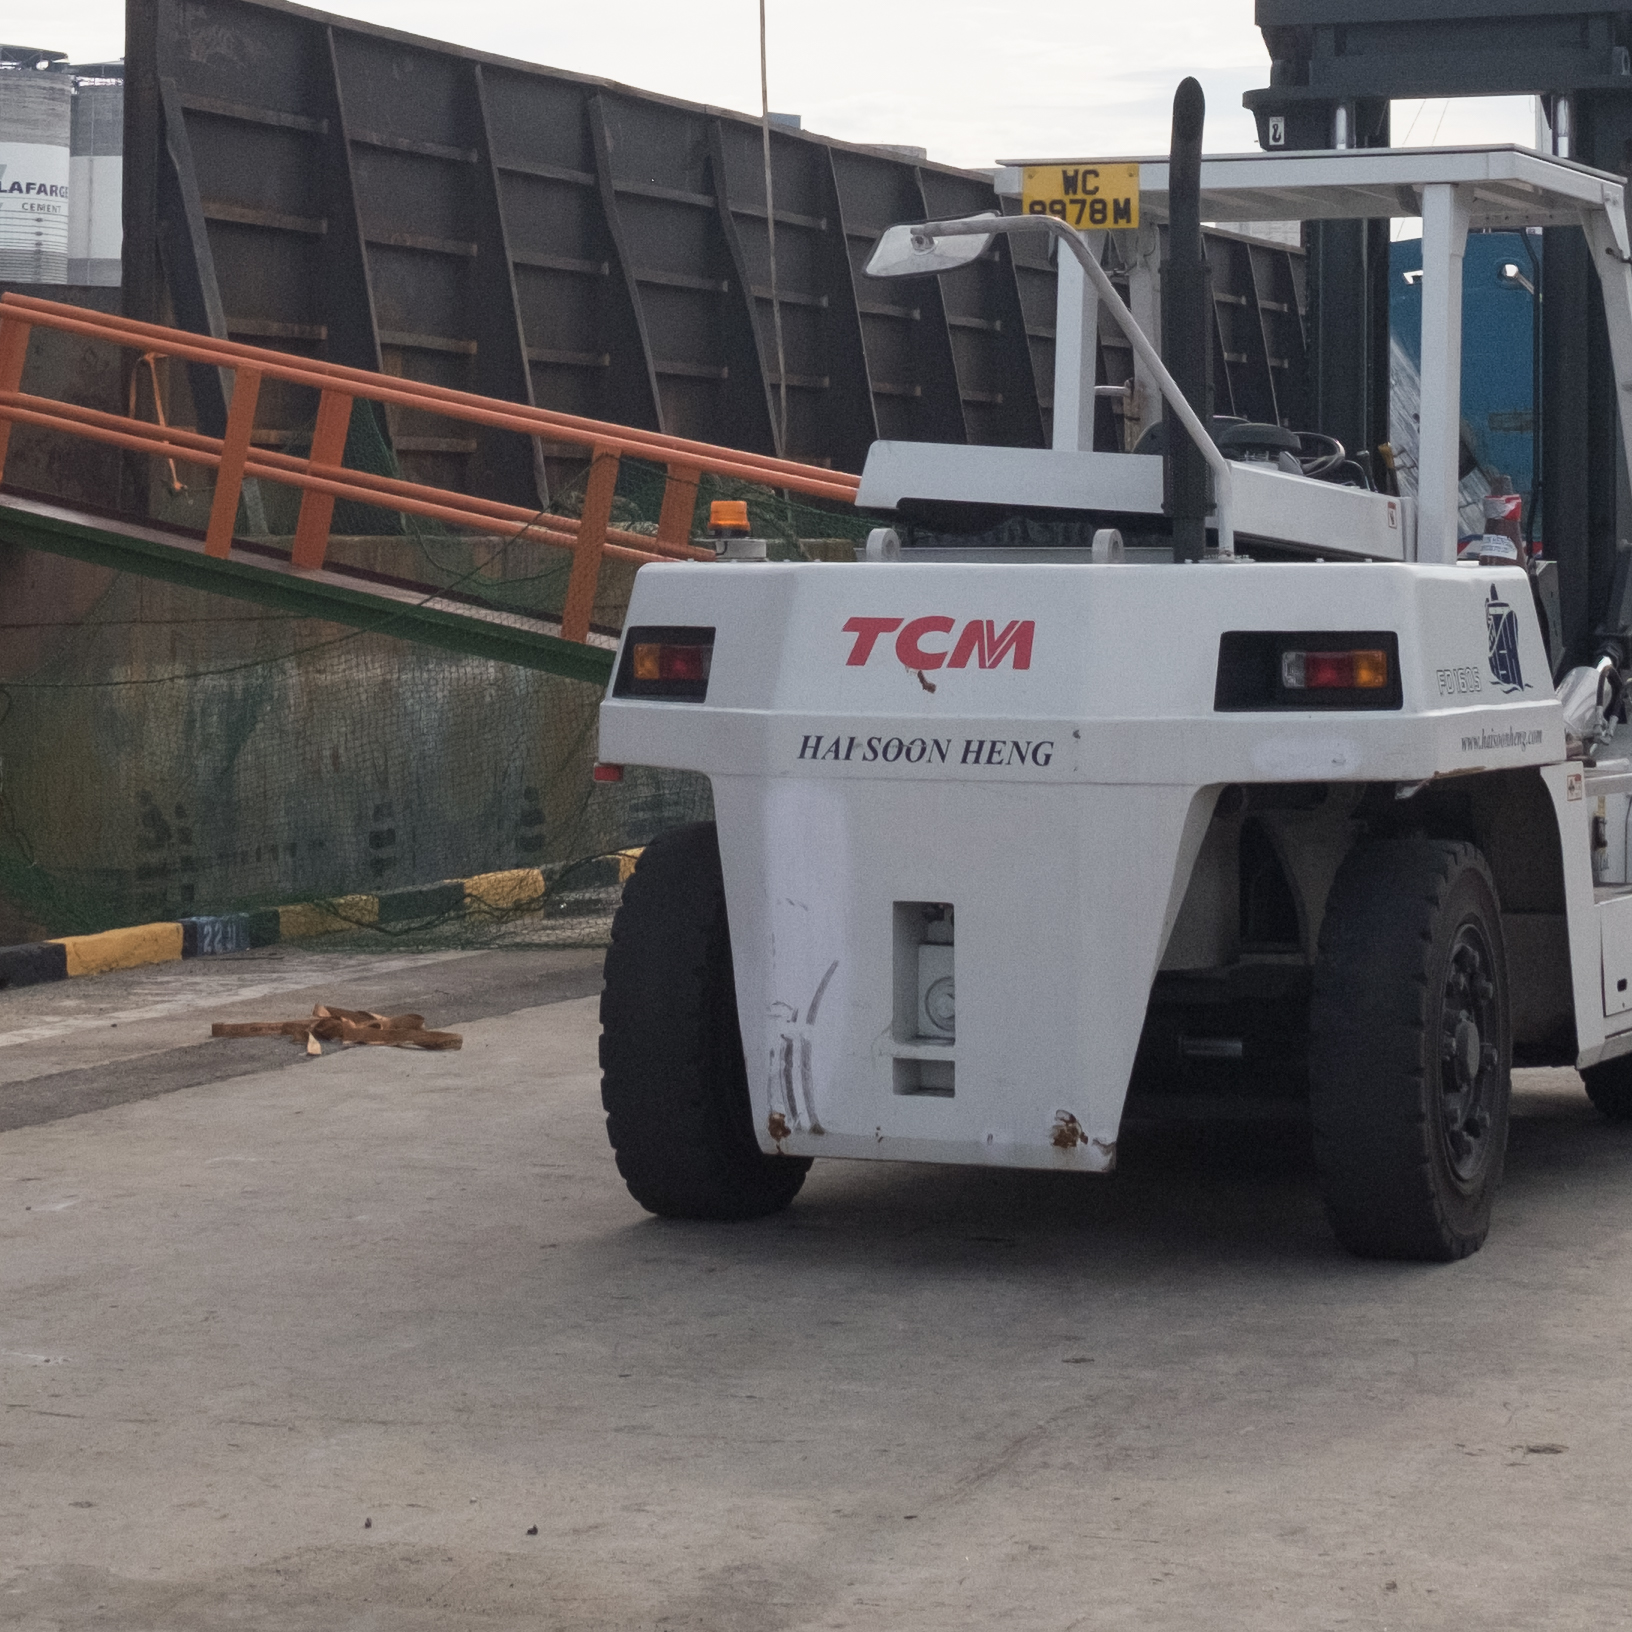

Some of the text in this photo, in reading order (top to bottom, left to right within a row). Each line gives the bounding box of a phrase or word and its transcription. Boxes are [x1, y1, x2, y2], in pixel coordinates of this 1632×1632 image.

[1062, 169, 1100, 196] WC
[22, 202, 61, 213] CEMENT
[842, 615, 1035, 670] TCM
[1436, 666, 1481, 696] FD160S
[797, 735, 1055, 766] HAI SOON HENG
[1461, 726, 1542, 751] www.haisoonheng.com
